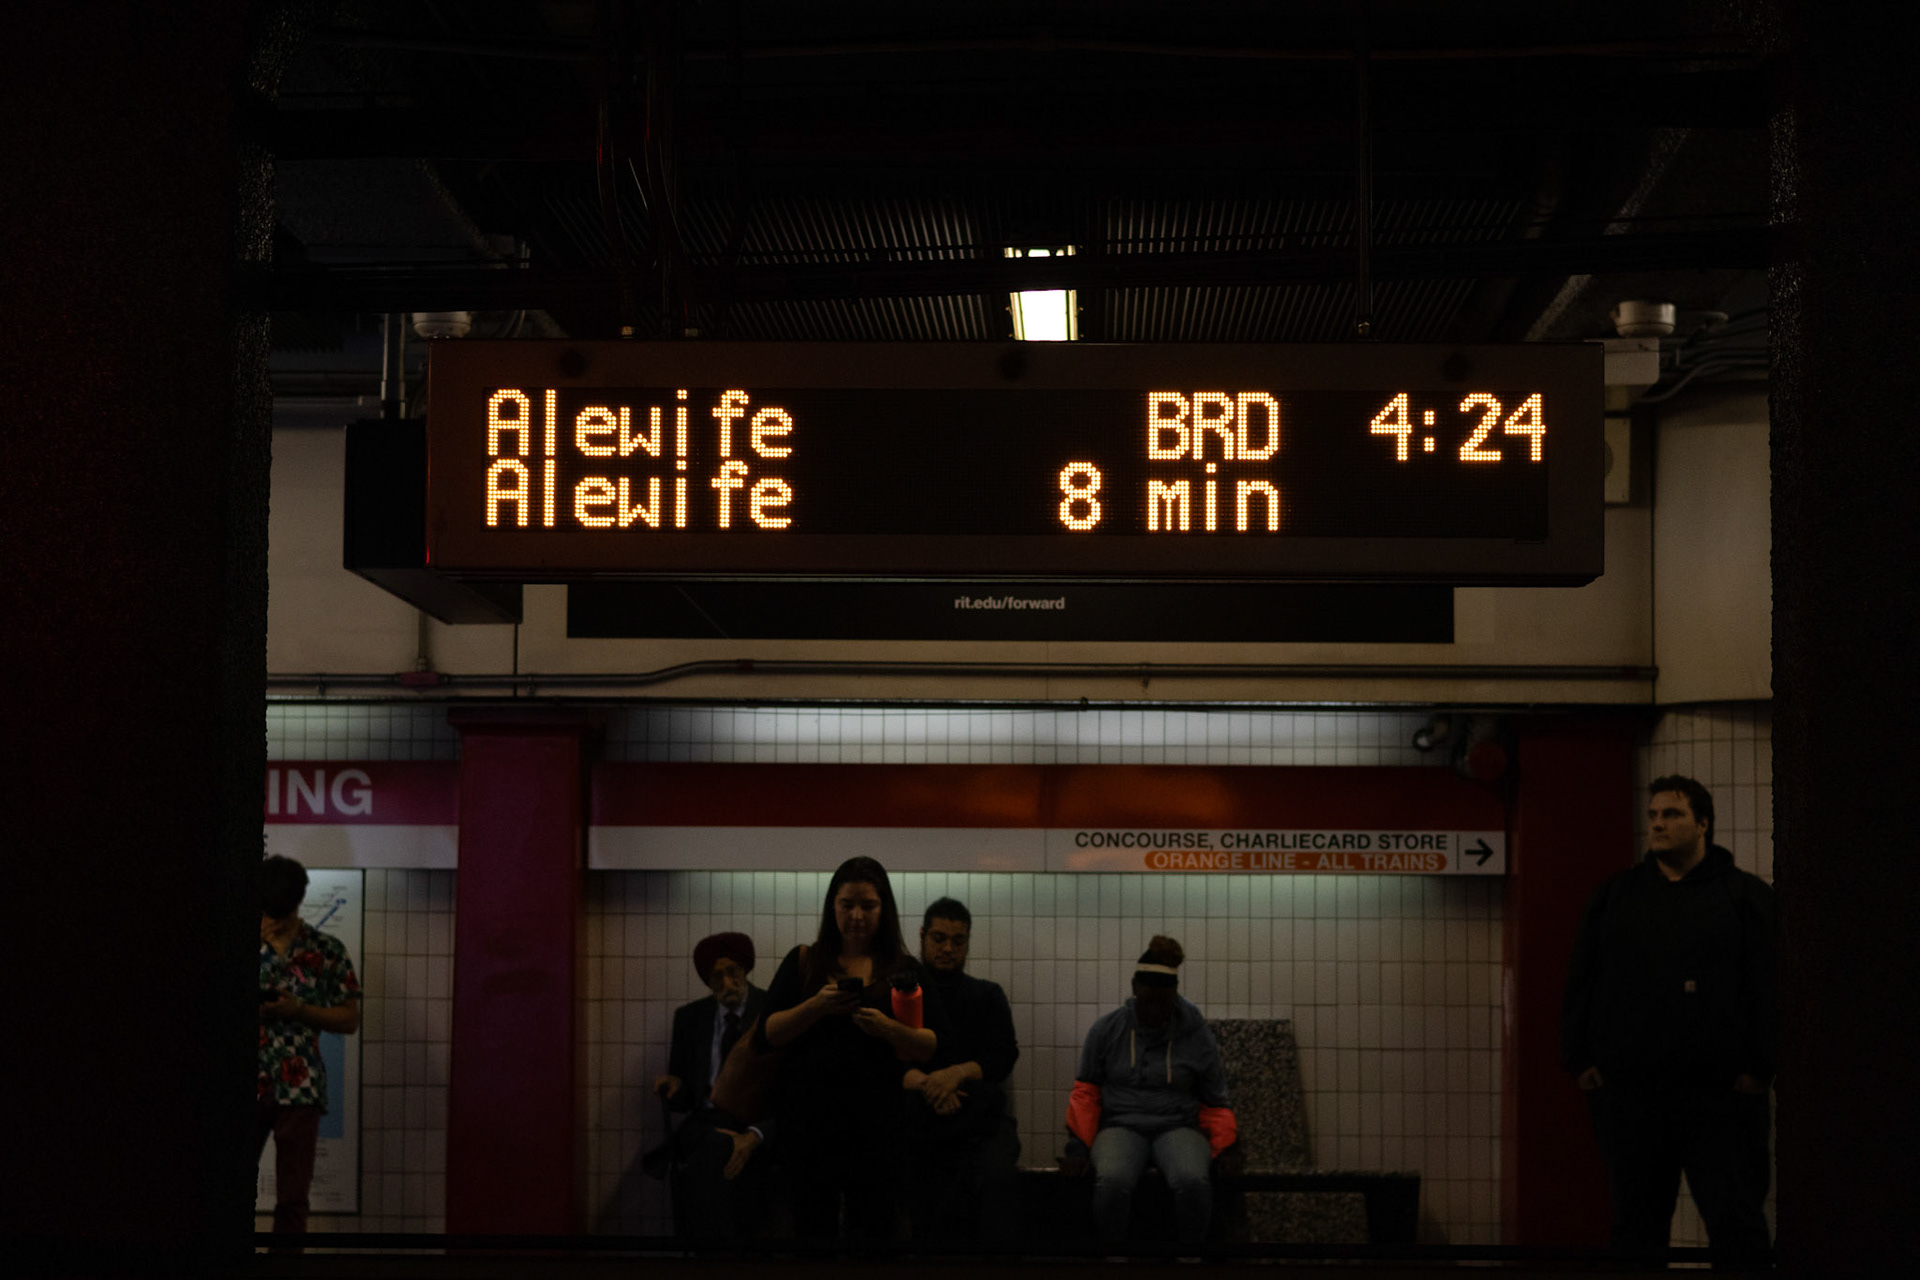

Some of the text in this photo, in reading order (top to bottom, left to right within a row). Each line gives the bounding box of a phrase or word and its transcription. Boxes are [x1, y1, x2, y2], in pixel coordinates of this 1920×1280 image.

[487, 388, 1547, 462] Alewife BRD 4:24
[486, 459, 1280, 531] Alewife 8 min
[954, 595, 1066, 609] rit.edu/forward
[1075, 831, 1448, 851] CONCOURSE, CHARLIECARD STORE
[1153, 852, 1243, 869] ORANGE
[1250, 853, 1297, 869] LINE
[1316, 853, 1356, 870] ALL
[1361, 853, 1440, 871] TRAINS
